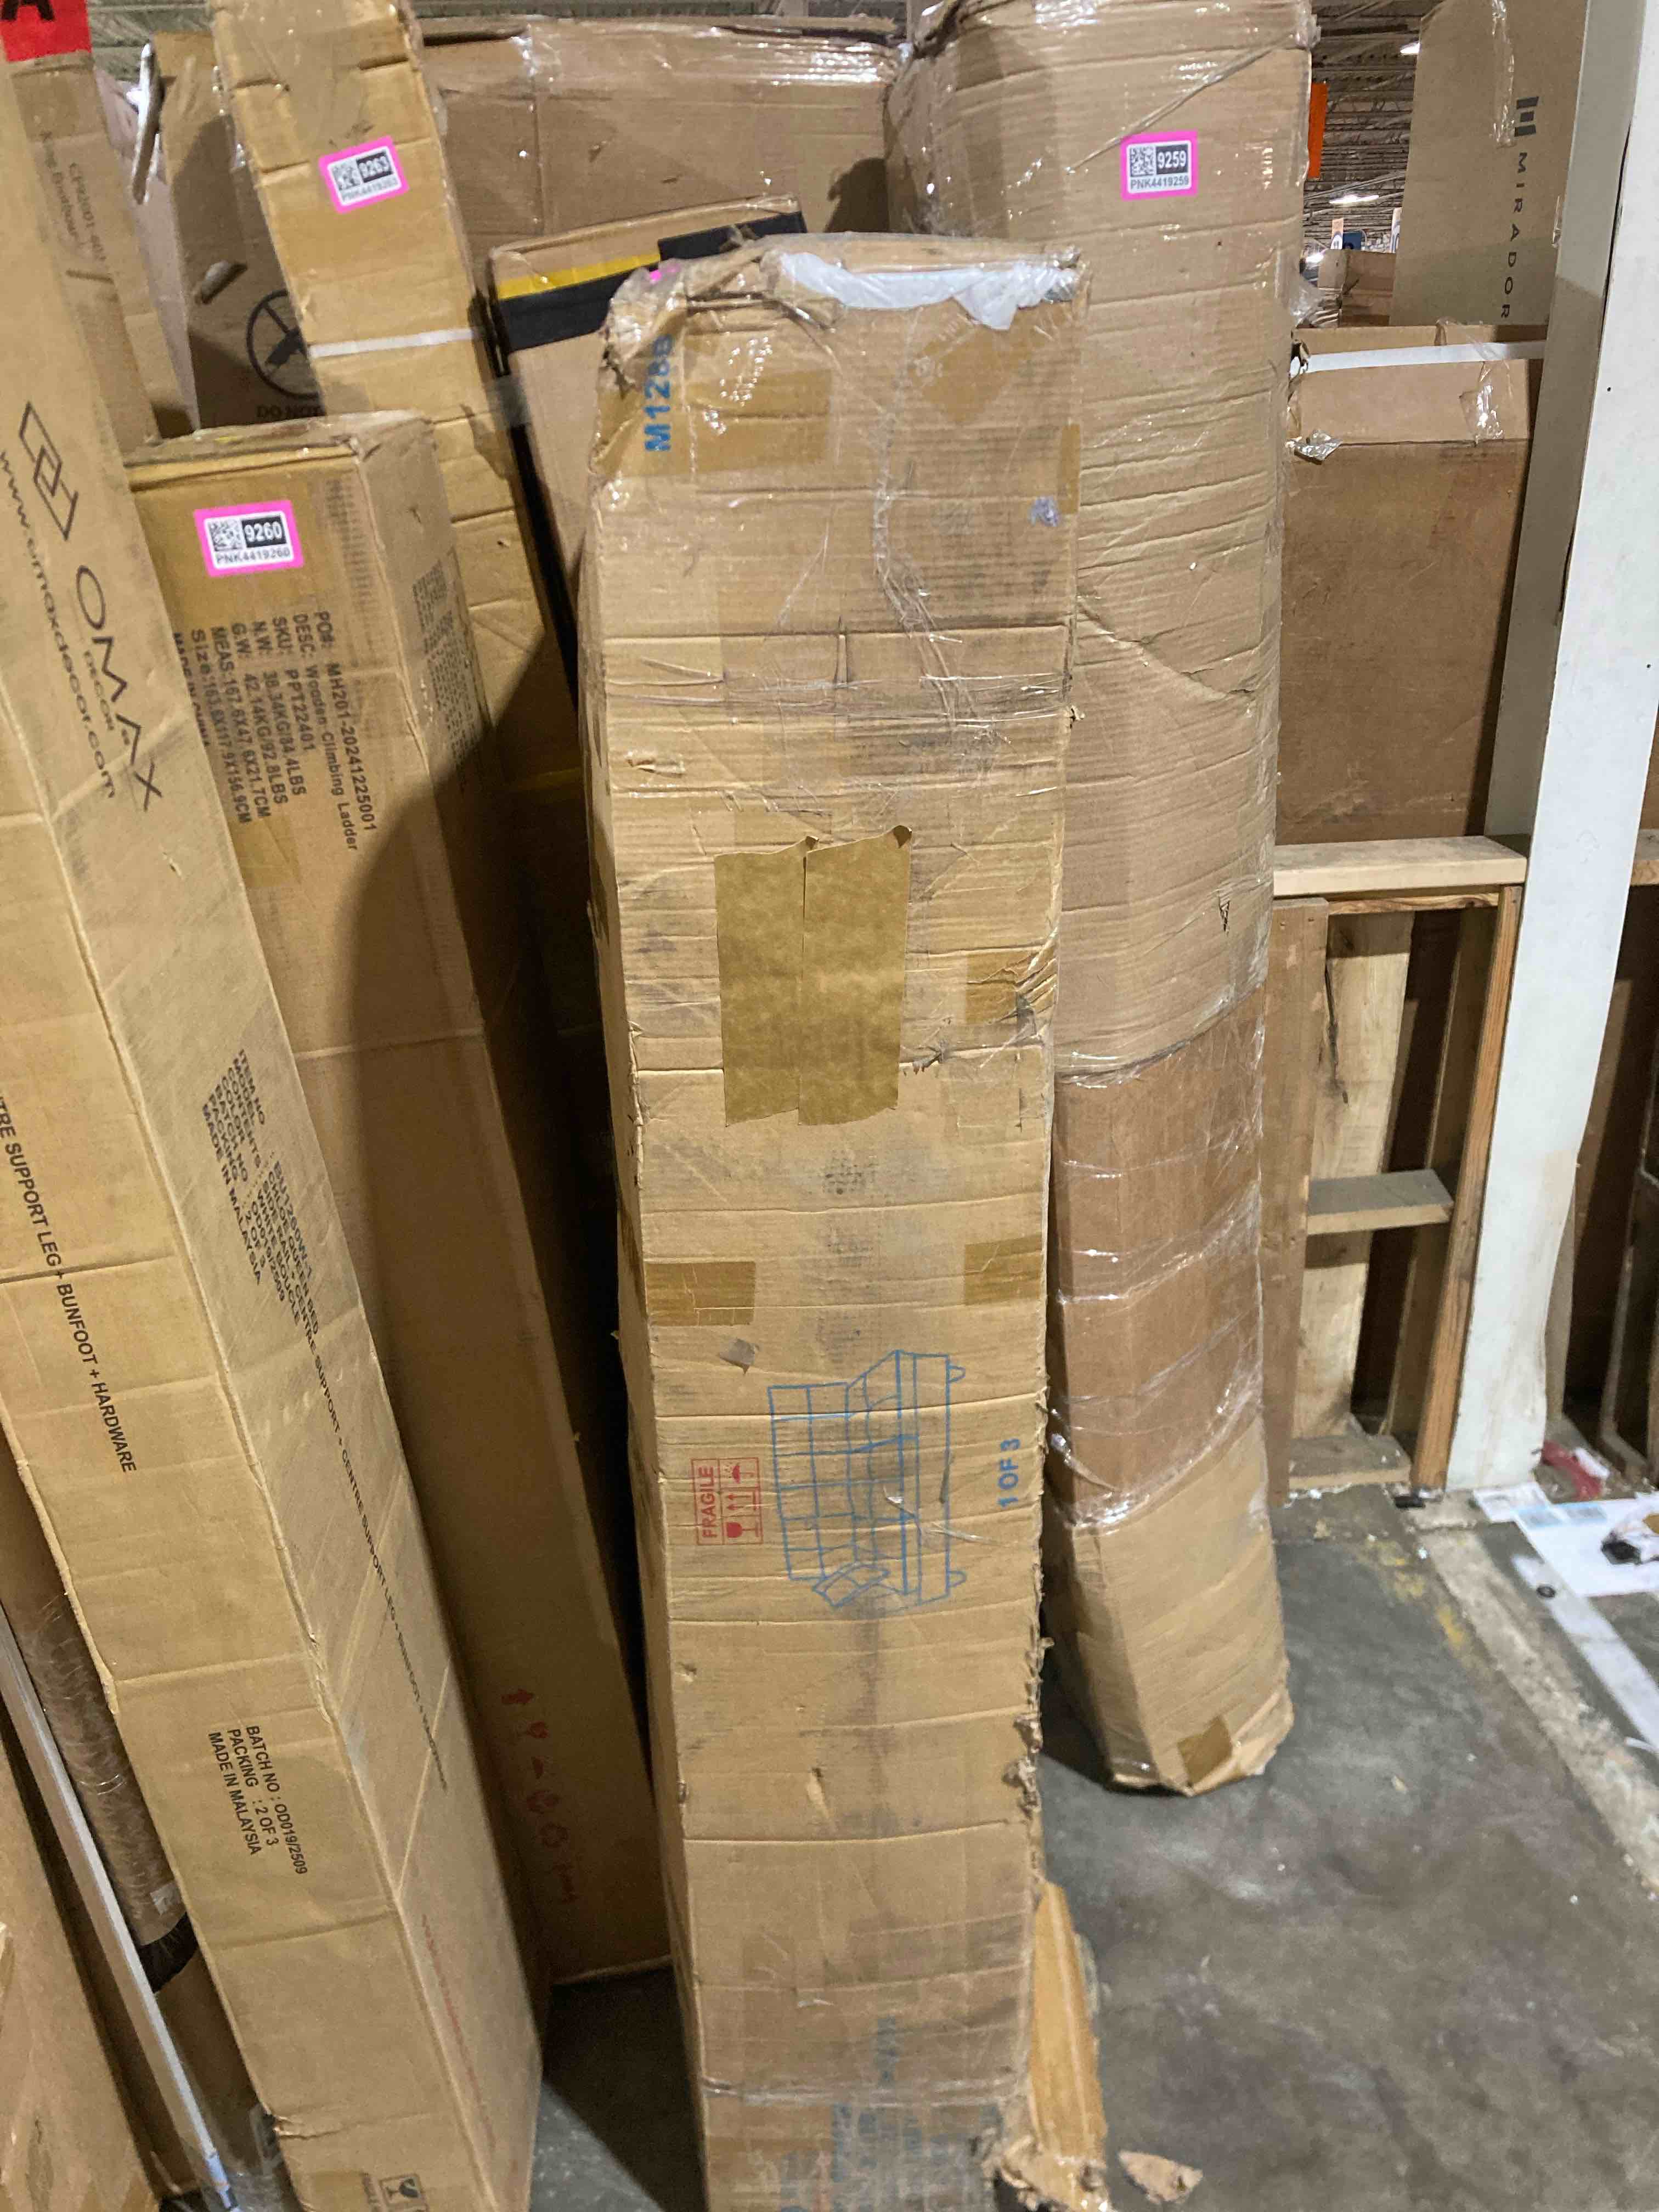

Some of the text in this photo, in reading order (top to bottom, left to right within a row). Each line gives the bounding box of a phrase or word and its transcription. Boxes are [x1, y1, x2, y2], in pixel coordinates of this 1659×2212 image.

[1130, 175, 1190, 190] PNK4419259
[1156, 150, 1187, 170] 9259
[1500, 153, 1528, 318] MIRADOR
[216, 548, 291, 563] PNK4419260
[244, 521, 283, 543] 9260
[76, 565, 162, 812] OMAX
[272, 616, 317, 753] SKU: PPT22401
[292, 613, 358, 851] DESC: Wooden Climbing Ladder
[326, 662, 377, 831] MH201-20241225001
[4, 1142, 49, 1227] SUPPORT
[37, 1231, 62, 1267] LEG
[268, 1171, 290, 1233] CHLOE
[288, 1235, 310, 1298] QUEEN
[56, 1283, 98, 1364] BUNFOOT
[295, 1284, 317, 1355] CENTRE
[315, 1355, 341, 1433] SUPPORT
[89, 1368, 100, 1379] +
[91, 1381, 137, 1473] HARDWARE
[698, 1465, 718, 1538] FRAGILE
[997, 1438, 1021, 1508] 1 OF 3
[208, 1731, 262, 1855] MADE IN MALAYSIA
[227, 1728, 259, 1787] PACKING
[246, 1725, 273, 1770] BATCH
[262, 1773, 280, 1793] NO
[274, 1803, 308, 1875] OD019/2509
[254, 1807, 268, 1815] 2
[259, 1816, 277, 1835] OF
[266, 1837, 279, 1846] 3
